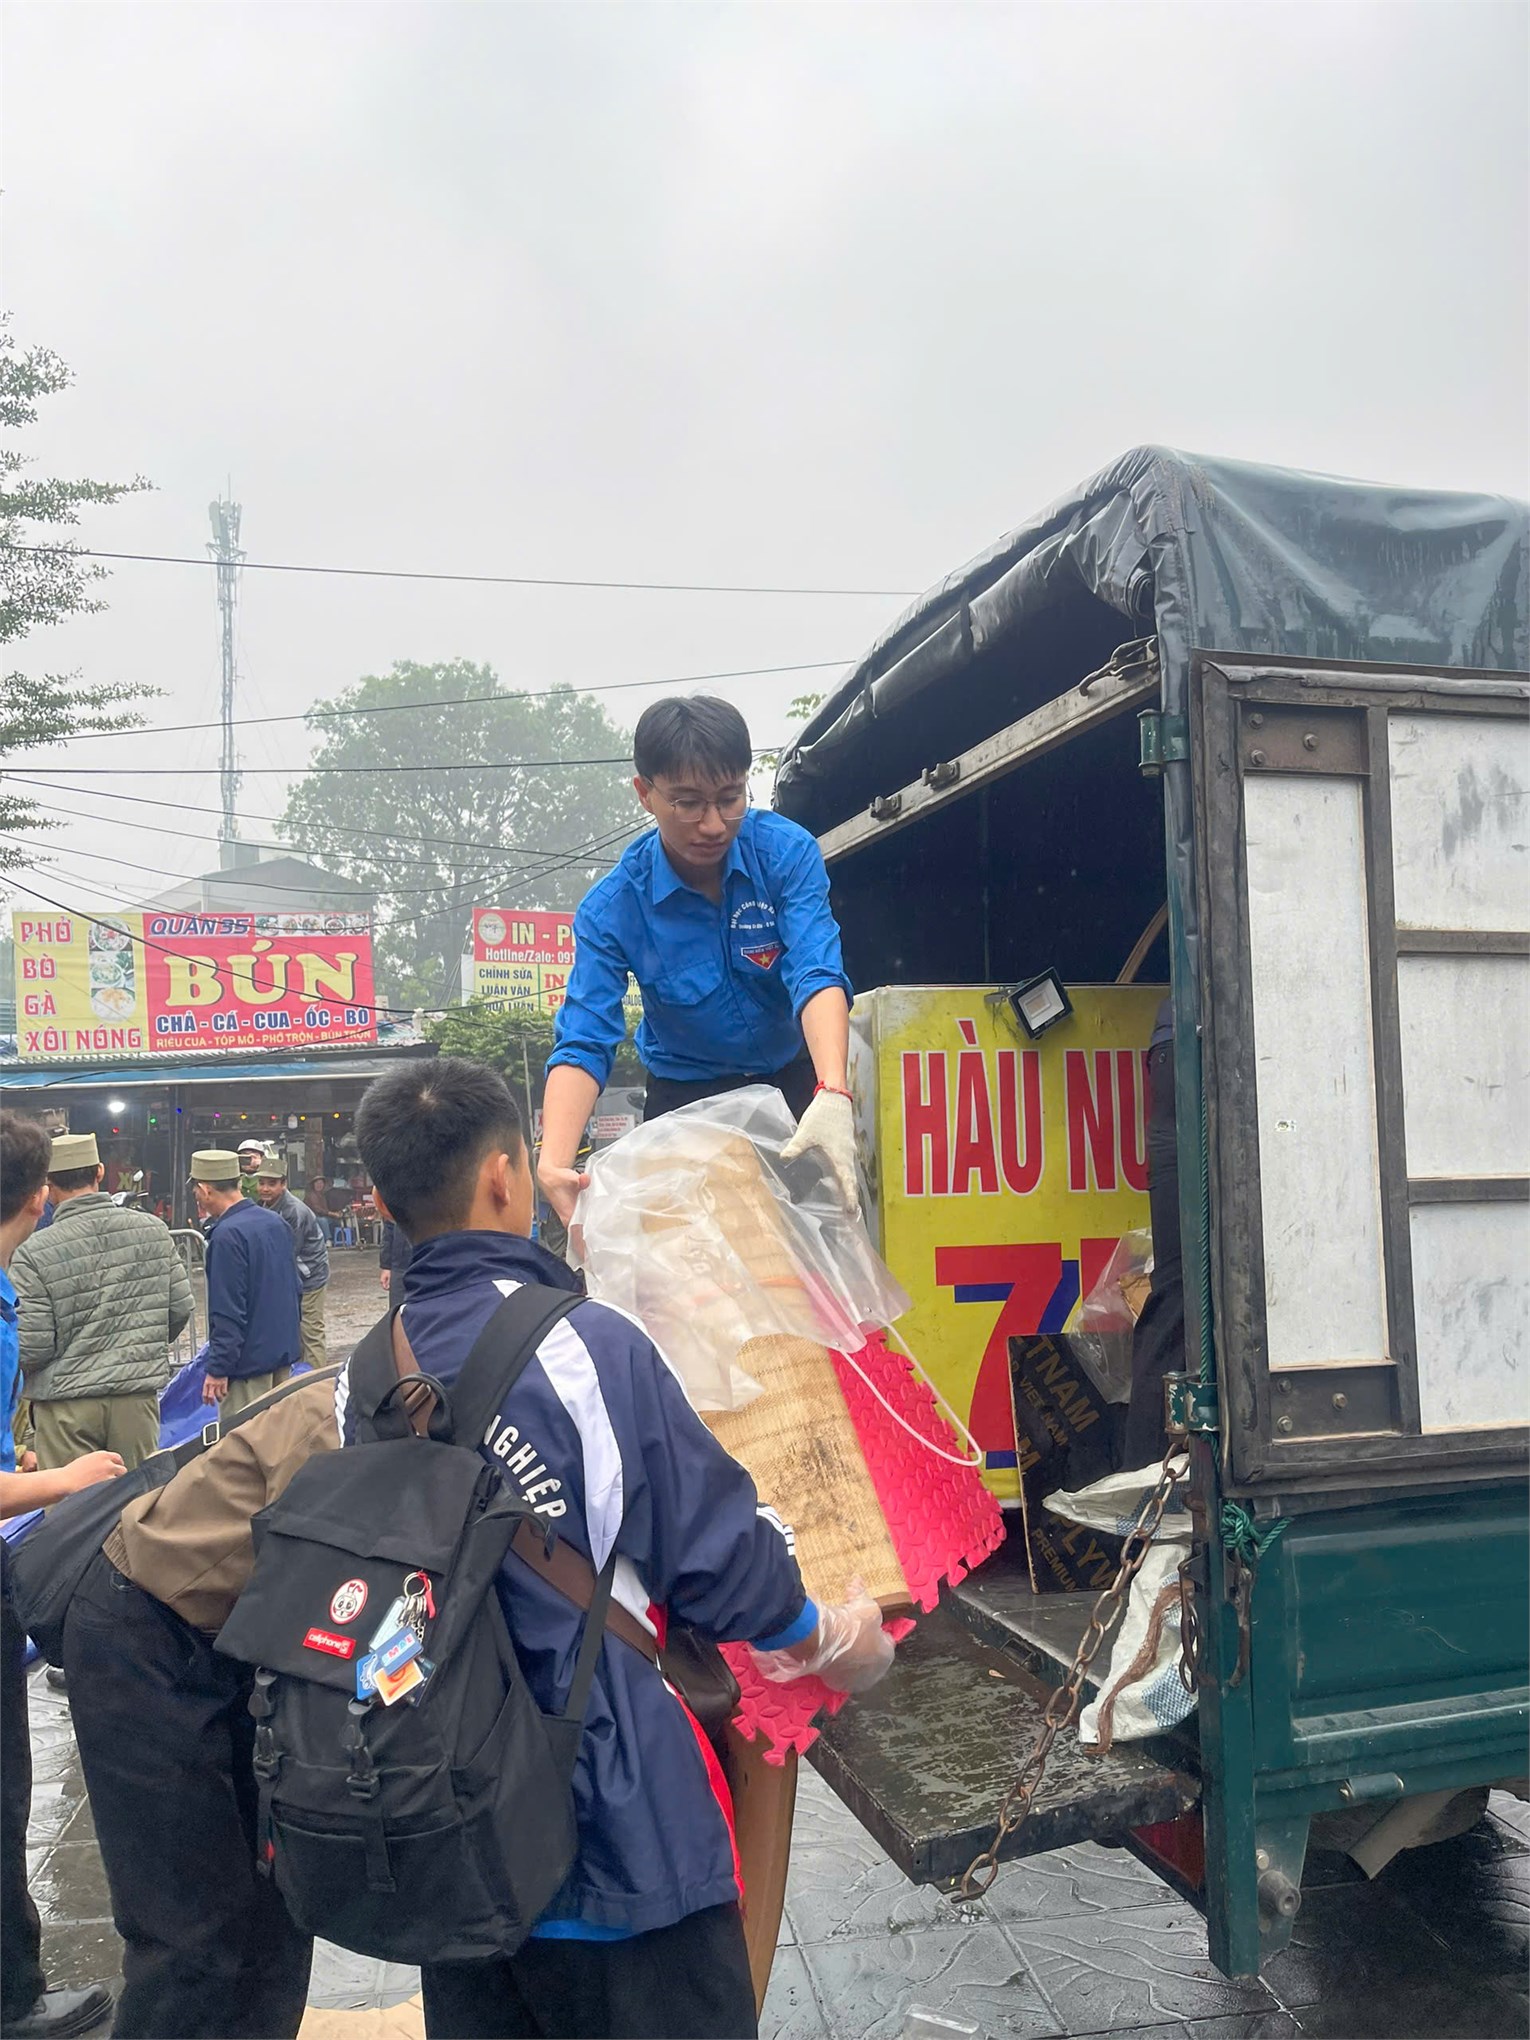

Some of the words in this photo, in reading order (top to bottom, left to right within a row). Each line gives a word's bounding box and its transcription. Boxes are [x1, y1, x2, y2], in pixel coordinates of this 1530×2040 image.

[20, 915, 73, 943] PHỞ
[221, 917, 251, 936] 35
[511, 922, 535, 945] IN
[22, 952, 56, 979] BÒ
[485, 947, 555, 963] Hotline/Zalo:
[163, 939, 358, 1006] BÚN
[479, 965, 510, 979] CHỈNH
[544, 973, 565, 989] IN
[24, 989, 57, 1015] GÀ
[156, 1010, 197, 1034] CHẢ
[212, 1010, 239, 1031] CÁ
[253, 1011, 291, 1030] CUA
[305, 1004, 331, 1027] ỐC
[25, 1025, 68, 1052] XÔI
[75, 1023, 142, 1050] NÓNG
[184, 1037, 207, 1047] CUA
[902, 1018, 1044, 1197] HÀU
